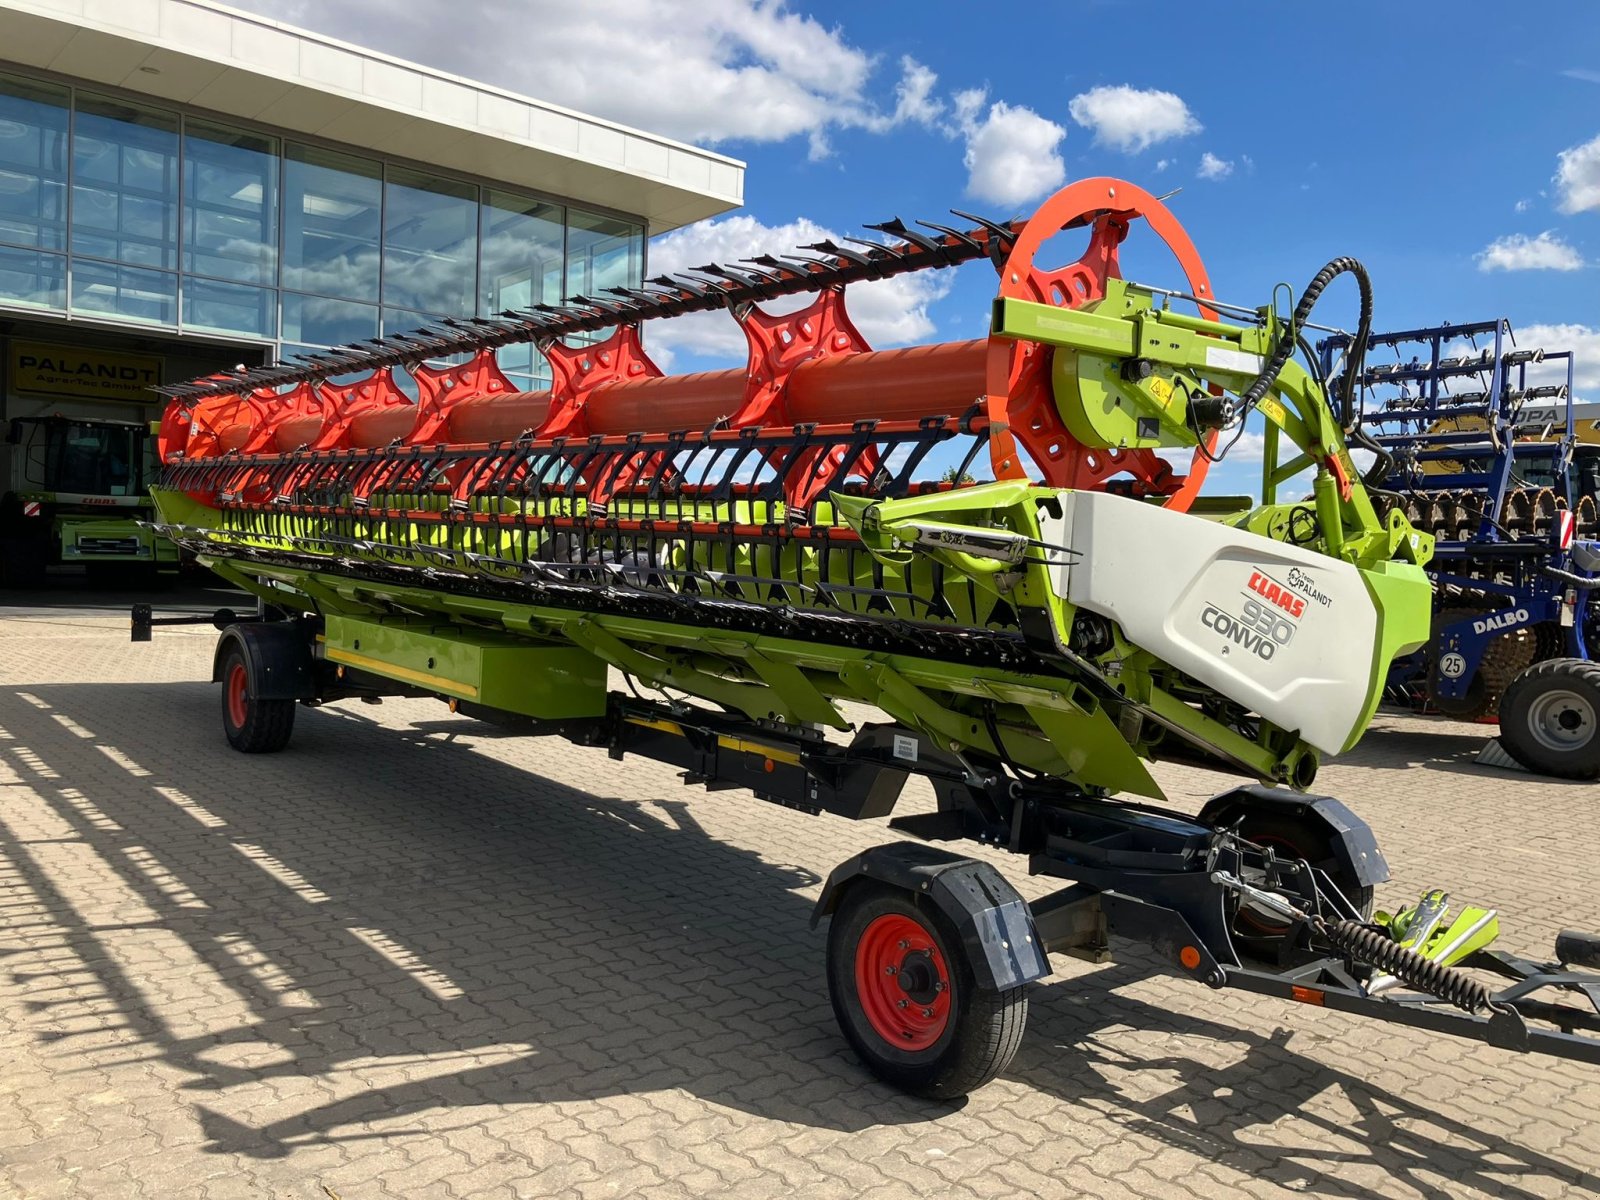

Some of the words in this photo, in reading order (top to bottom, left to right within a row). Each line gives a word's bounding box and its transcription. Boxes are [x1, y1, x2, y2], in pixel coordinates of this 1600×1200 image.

[19, 355, 154, 382] PALANDT
[101, 381, 141, 391] GmbH
[1301, 572, 1315, 585] Team
[1247, 571, 1305, 618] CLAAS
[1298, 579, 1333, 608] PALANDT
[1201, 606, 1275, 661] CONVIO
[1239, 600, 1293, 645] 930
[1472, 608, 1530, 635] DALBO
[1445, 657, 1461, 674] 25
